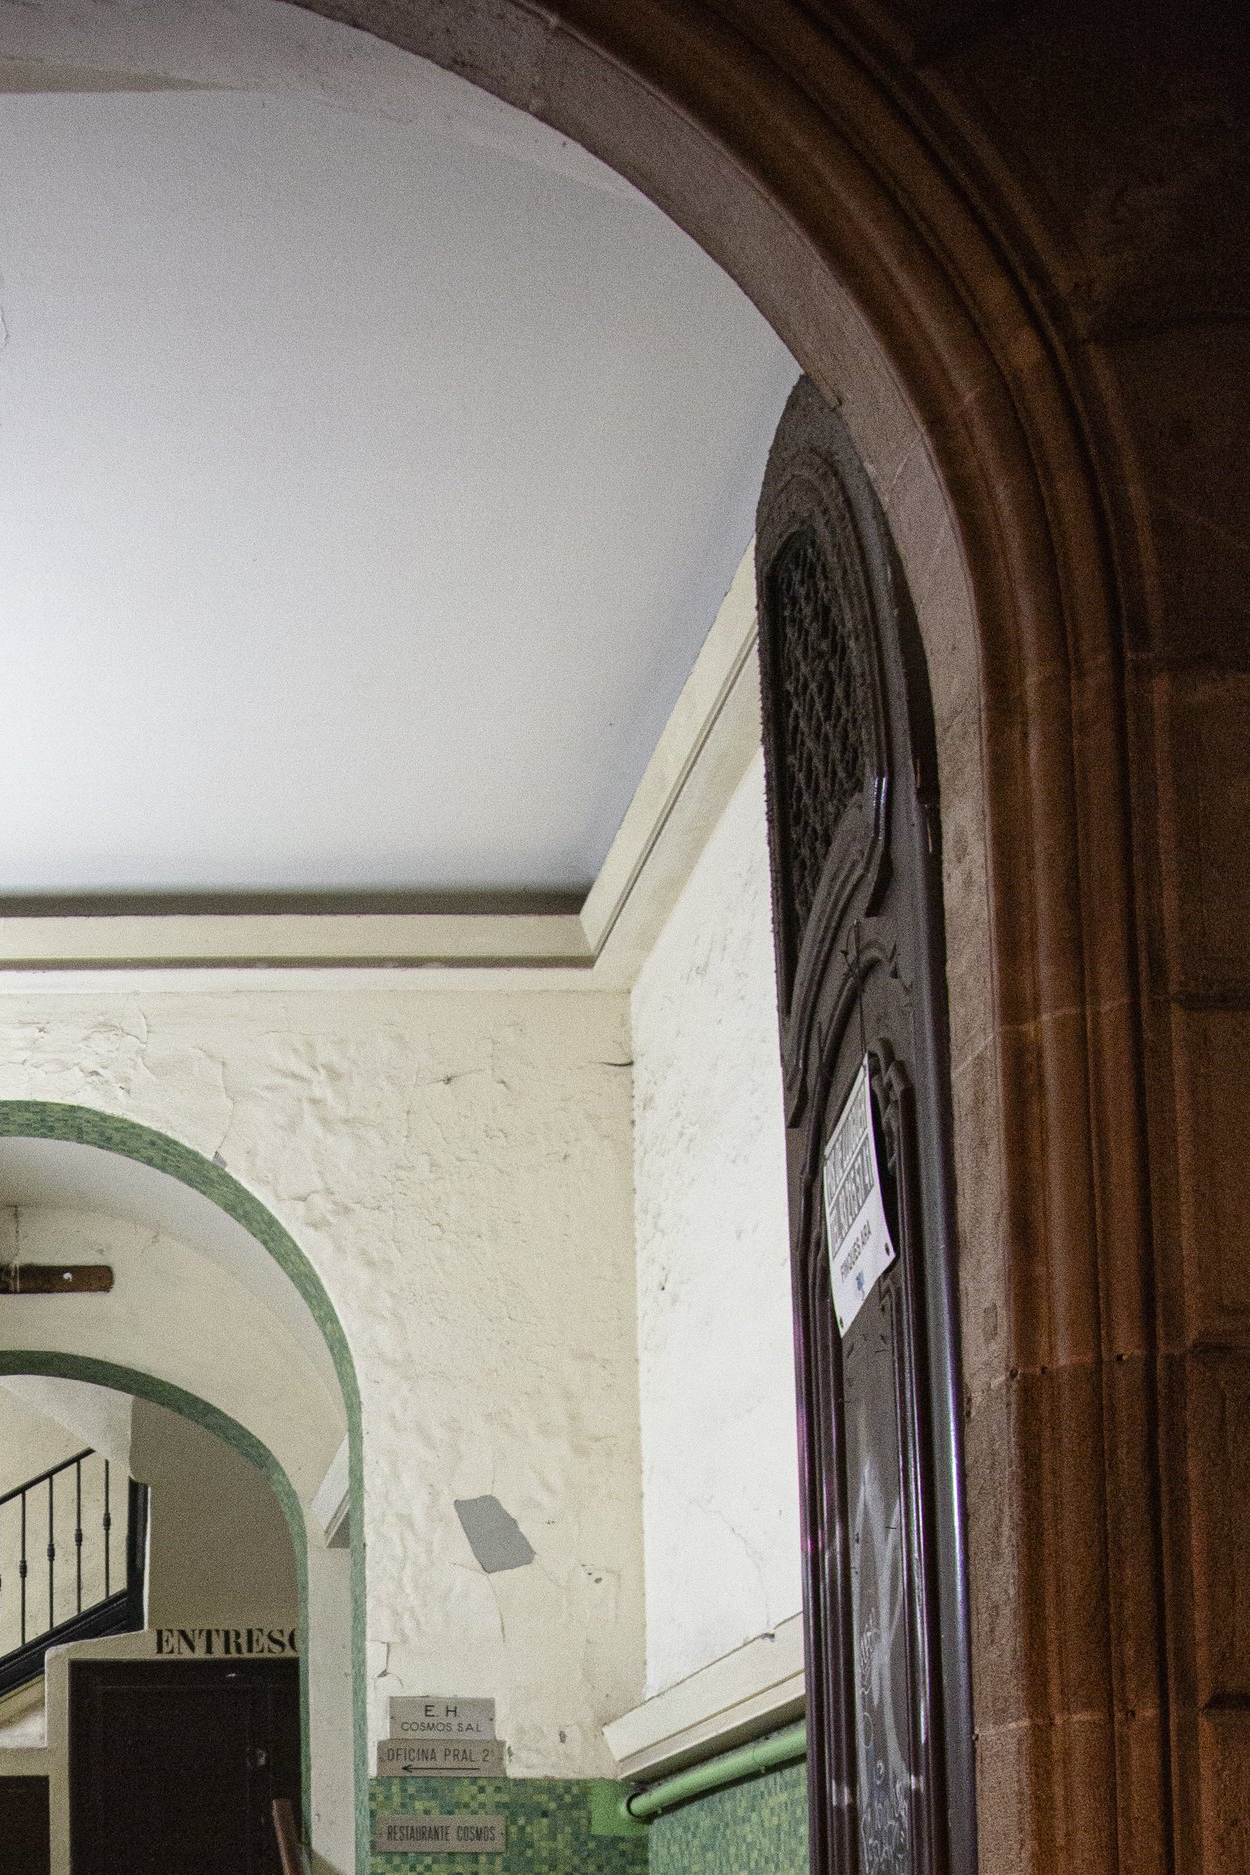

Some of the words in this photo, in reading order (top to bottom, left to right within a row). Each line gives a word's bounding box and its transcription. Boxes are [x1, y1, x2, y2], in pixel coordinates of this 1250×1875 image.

[400, 1721, 453, 1732] COSMOS
[456, 1722, 482, 1733] SAL
[387, 1747, 437, 1761] OFICINA
[387, 1825, 451, 1842] RESTAURANTE
[456, 1825, 496, 1842] COSMOS
